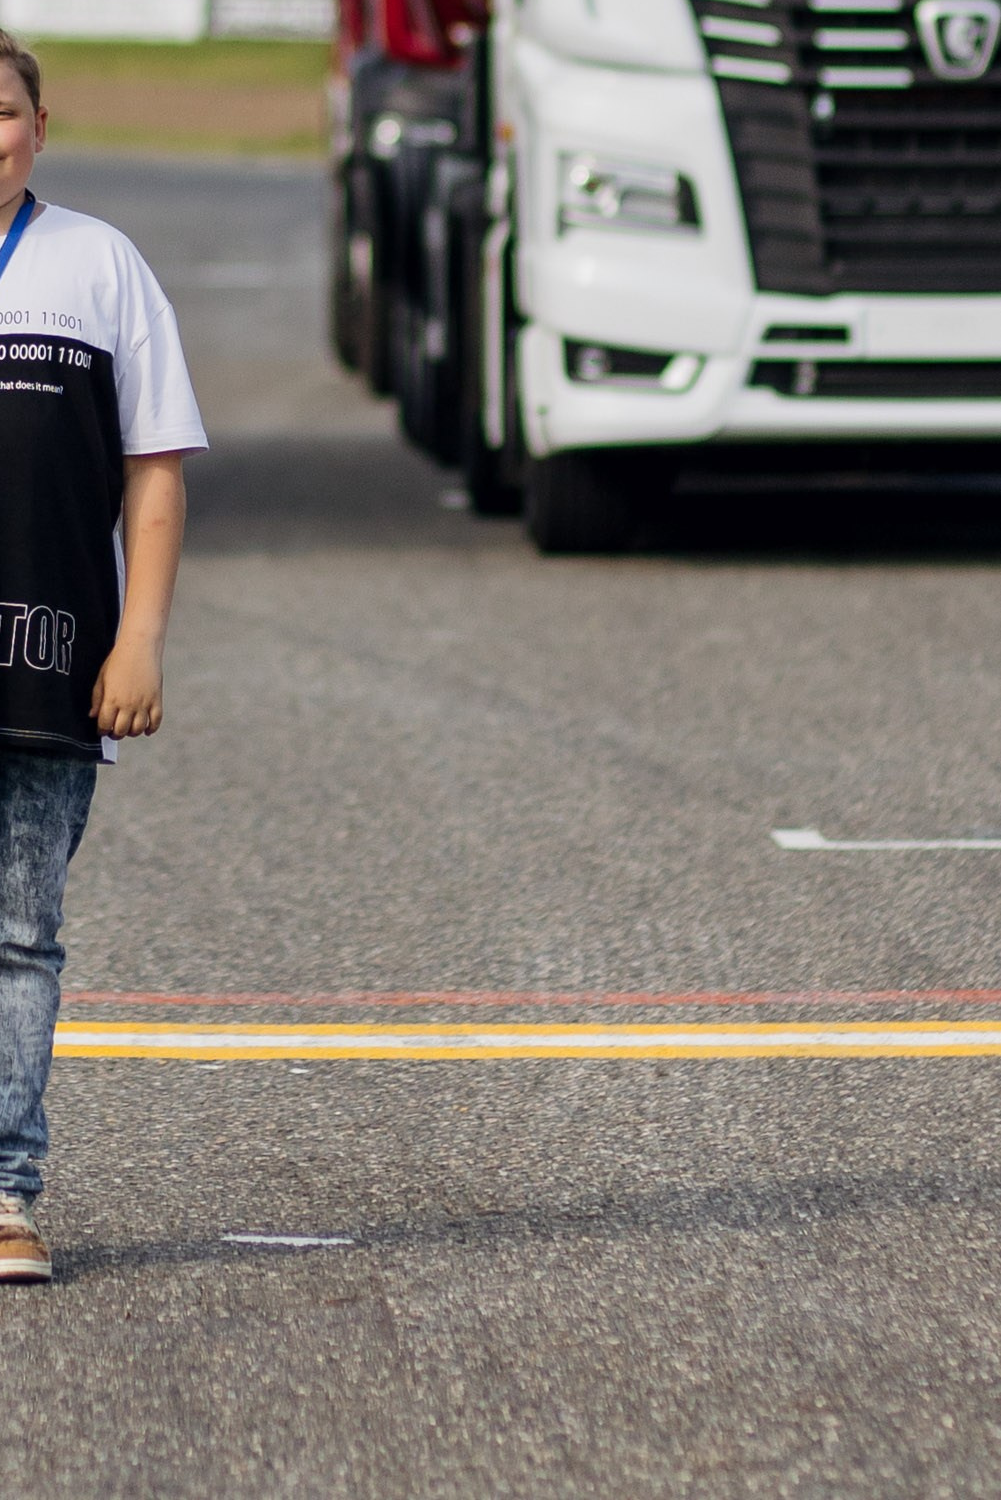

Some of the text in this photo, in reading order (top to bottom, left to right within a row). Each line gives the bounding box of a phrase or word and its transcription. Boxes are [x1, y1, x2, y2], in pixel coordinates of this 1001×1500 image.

[42, 311, 83, 332] 11001
[9, 343, 53, 362] 00001
[58, 346, 92, 370] 11001
[16, 380, 34, 390] does
[36, 382, 41, 391] it
[43, 384, 63, 395] mean?
